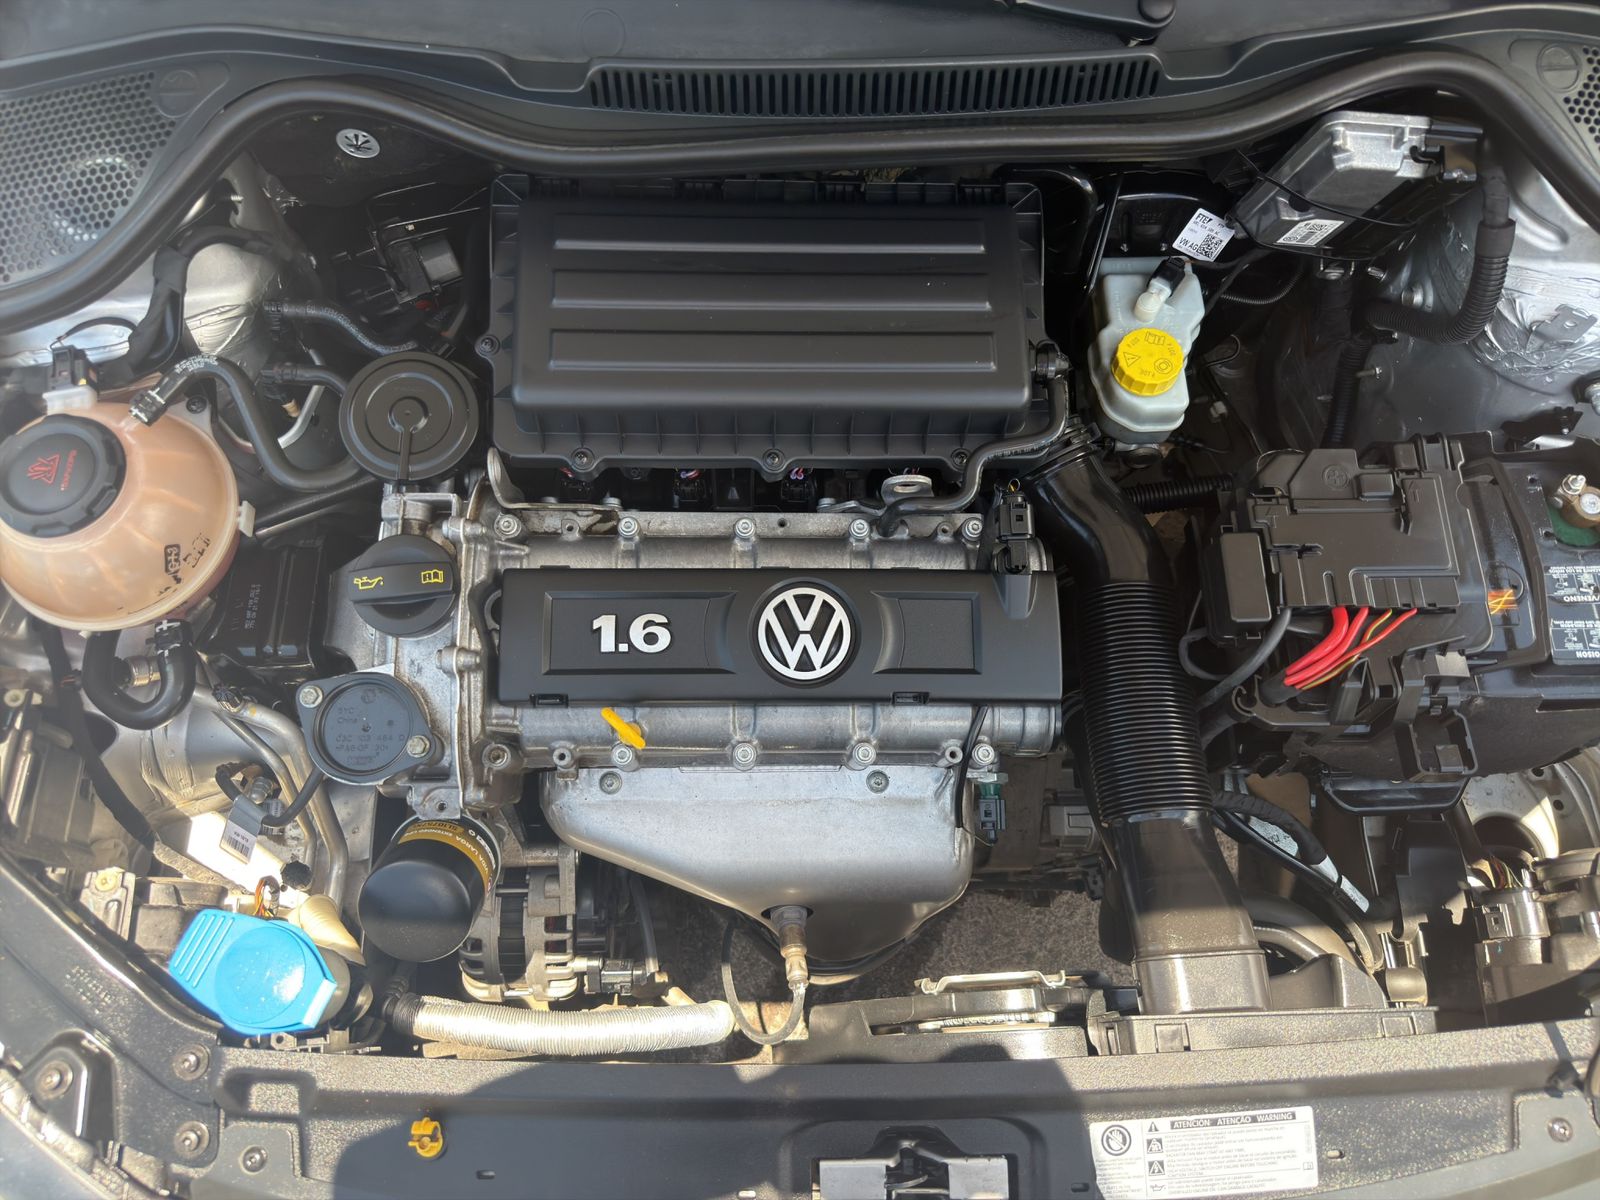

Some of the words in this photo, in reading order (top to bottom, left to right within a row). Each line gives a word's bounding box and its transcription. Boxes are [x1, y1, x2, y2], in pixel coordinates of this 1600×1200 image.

[592, 613, 671, 653] 1.6
[1575, 650, 1600, 658] OISON
[455, 835, 479, 856] LARGA
[479, 854, 489, 873] VIDA
[1256, 1112, 1292, 1122] WARNING
